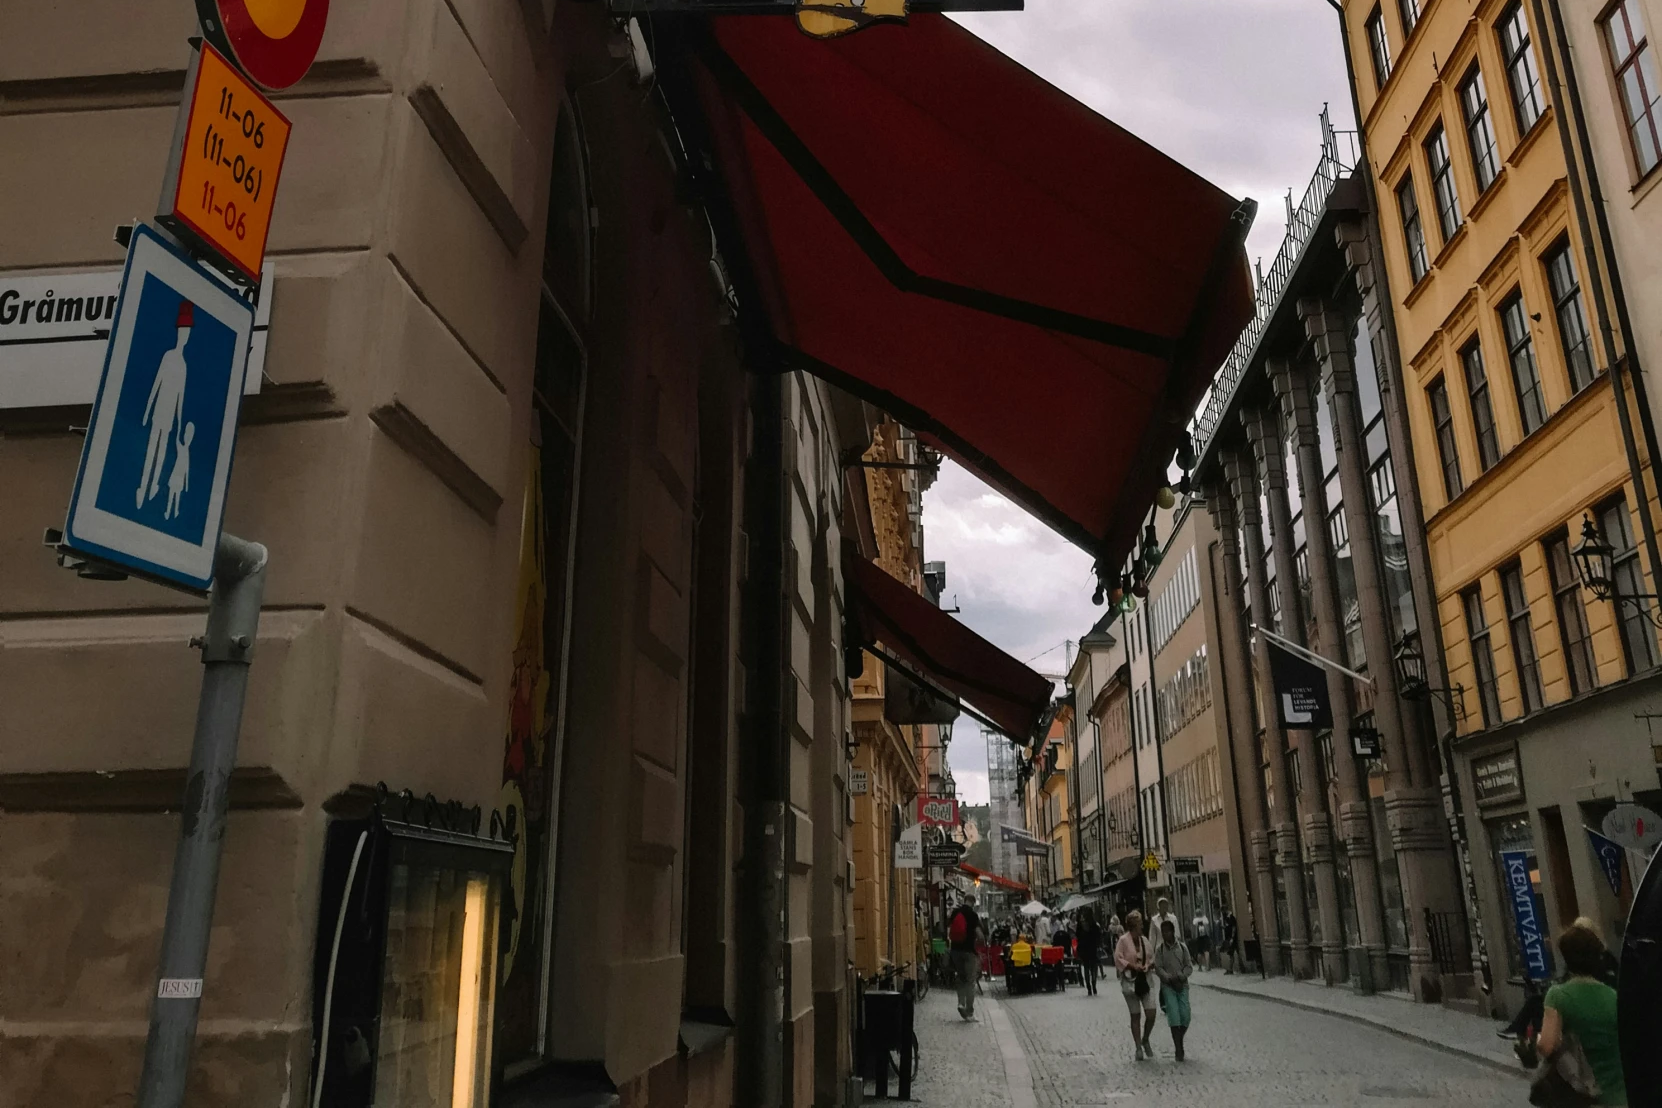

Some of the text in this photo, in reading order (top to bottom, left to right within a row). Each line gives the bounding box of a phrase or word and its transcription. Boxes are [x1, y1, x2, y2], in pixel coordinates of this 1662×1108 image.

[219, 86, 265, 149] 11-06
[203, 123, 263, 203] (11-06)
[201, 180, 247, 241] 11-06
[1507, 858, 1546, 971] KEMTVÄTT
[161, 982, 189, 995] JESUS
